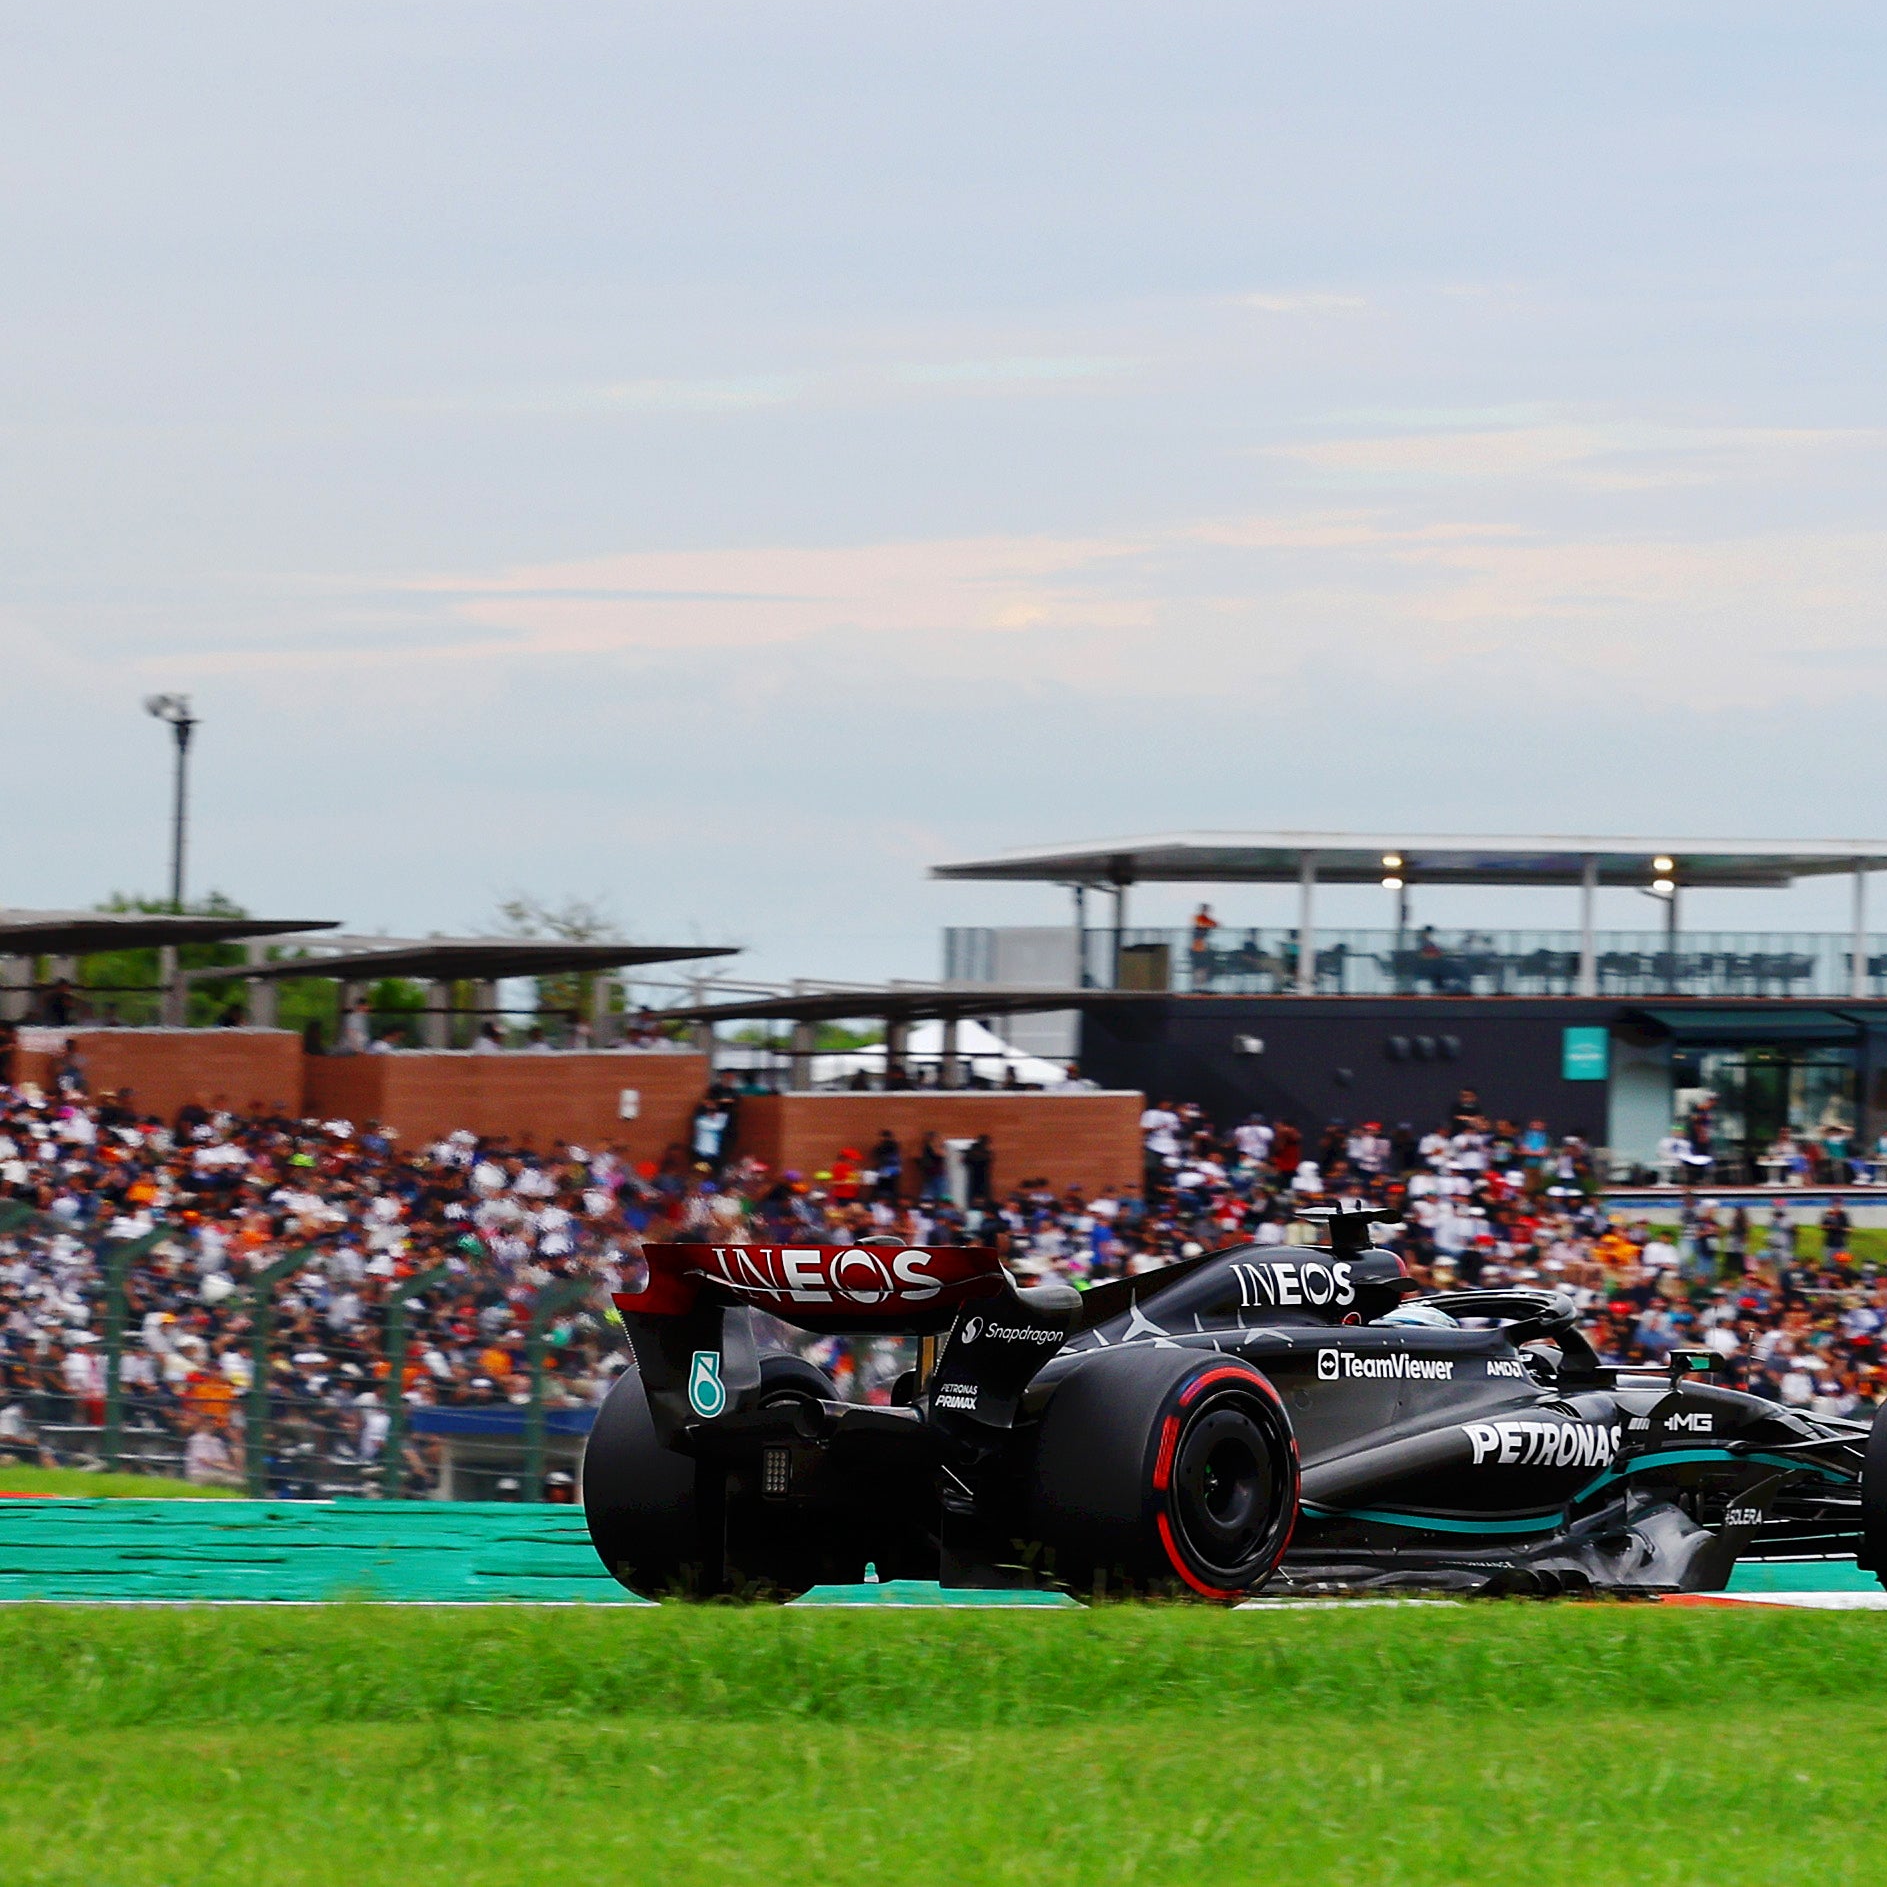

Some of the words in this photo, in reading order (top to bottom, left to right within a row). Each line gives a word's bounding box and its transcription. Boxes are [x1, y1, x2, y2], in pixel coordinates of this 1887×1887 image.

[712, 1248, 944, 1304] INEOS
[1229, 1262, 1356, 1307] INEOS
[985, 1321, 1064, 1344] Snapdragon
[1340, 1351, 1454, 1380] TeamViewer
[935, 1395, 977, 1411] PRIMAX
[940, 1382, 979, 1396] PETRONAS
[1461, 1420, 1622, 1468] PETRONAS
